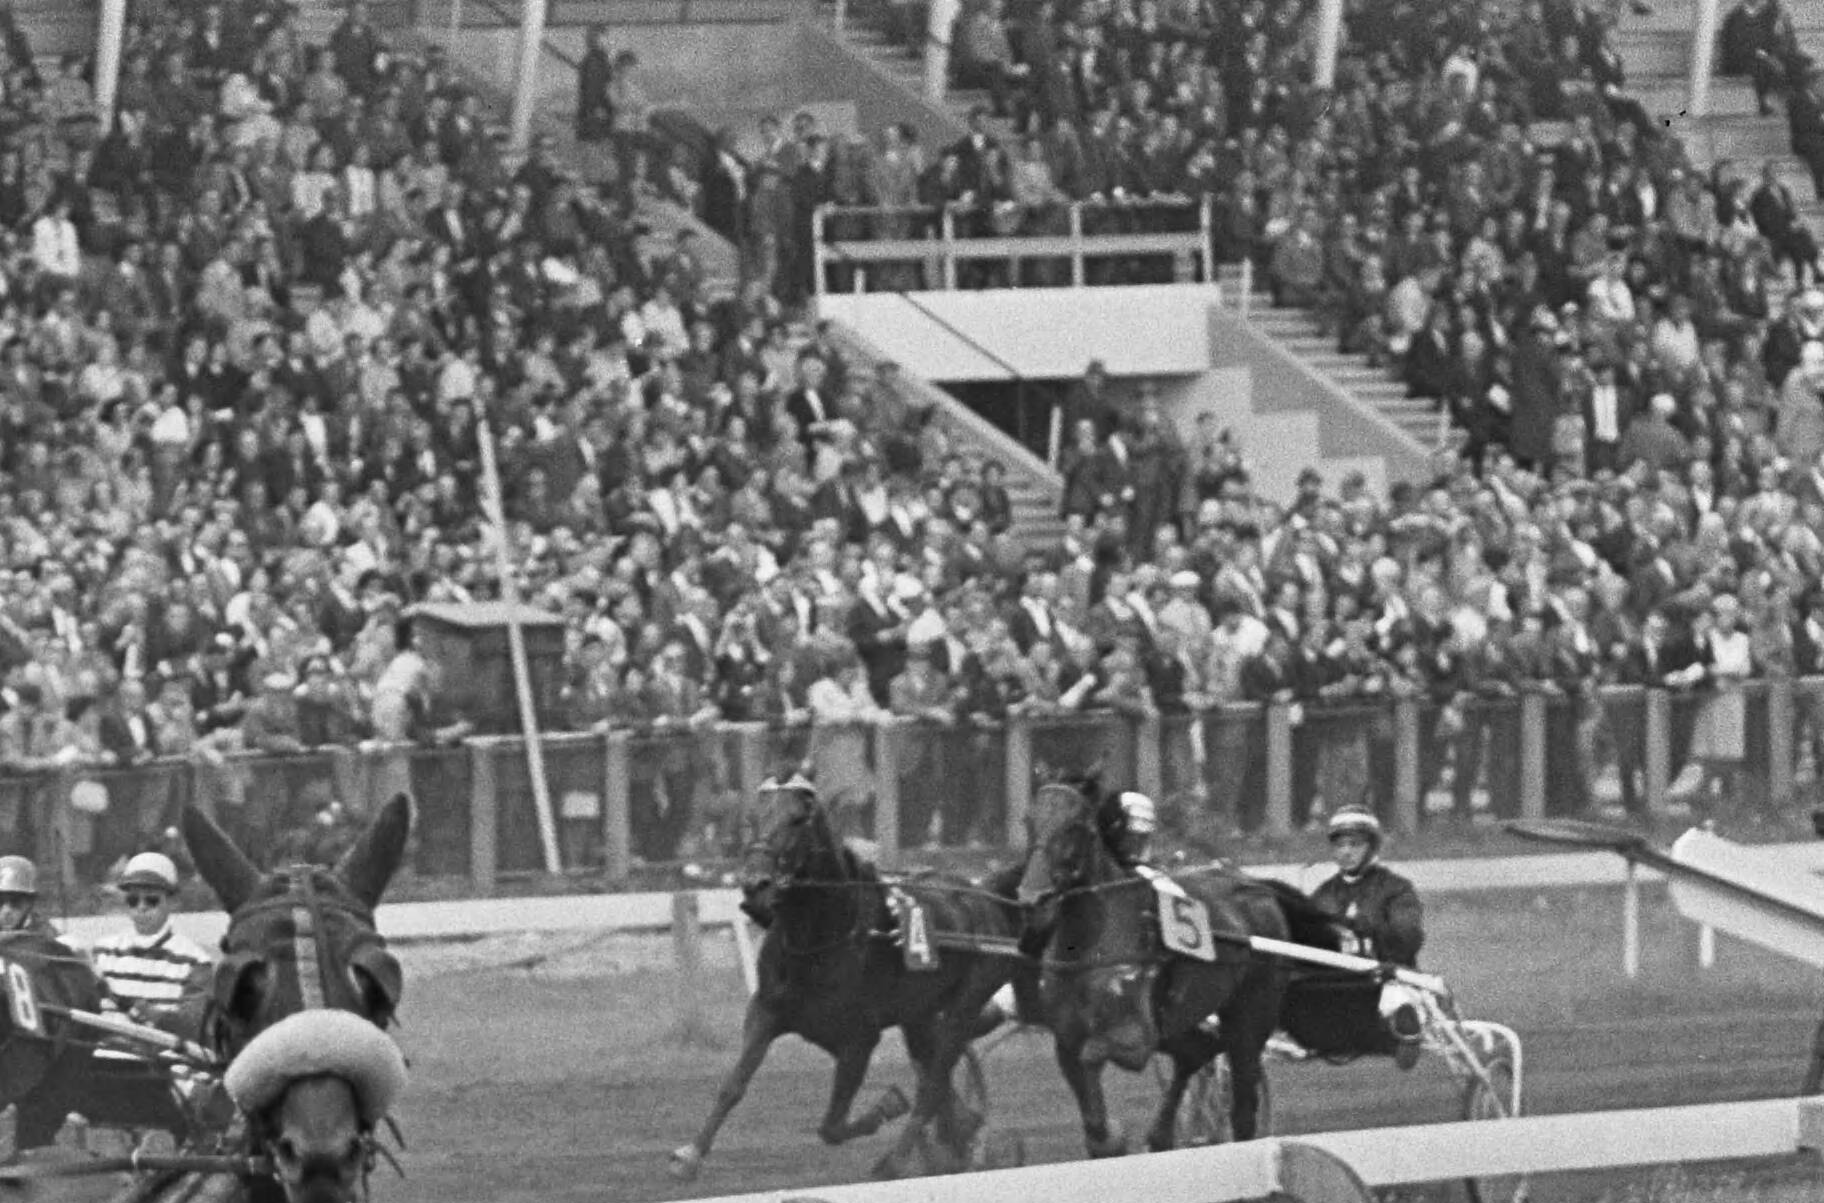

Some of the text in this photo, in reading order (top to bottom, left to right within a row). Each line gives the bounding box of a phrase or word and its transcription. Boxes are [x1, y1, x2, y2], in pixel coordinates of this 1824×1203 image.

[909, 905, 930, 964] 4
[1172, 895, 1203, 949] 5
[9, 963, 37, 1031] 8
